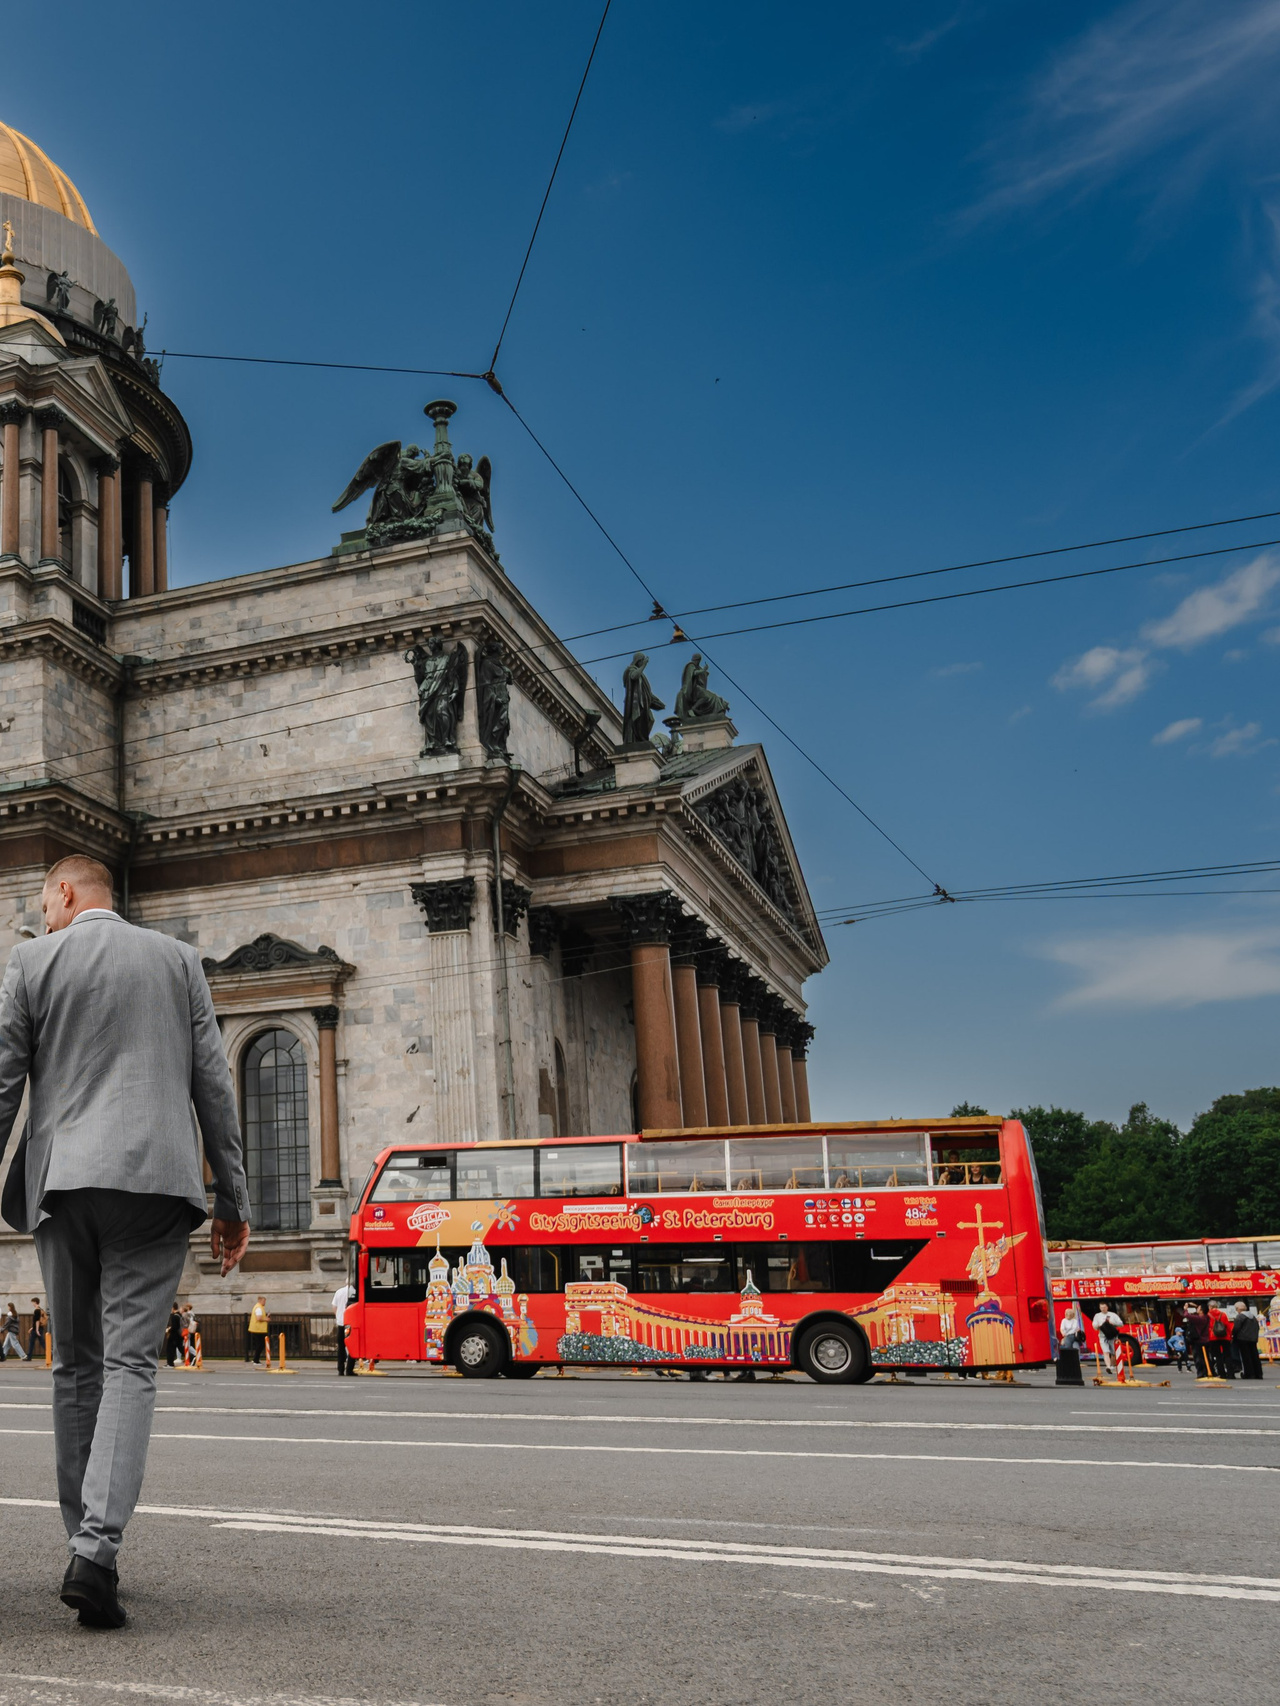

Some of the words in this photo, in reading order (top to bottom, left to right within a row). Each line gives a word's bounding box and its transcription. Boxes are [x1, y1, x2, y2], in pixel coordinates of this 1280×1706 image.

[412, 1211, 447, 1226] OFFICIAL
[423, 1221, 439, 1230] TOUR
[529, 1212, 642, 1233] CitySightseeing
[663, 1210, 681, 1229] St
[683, 1209, 774, 1230] Petersburg
